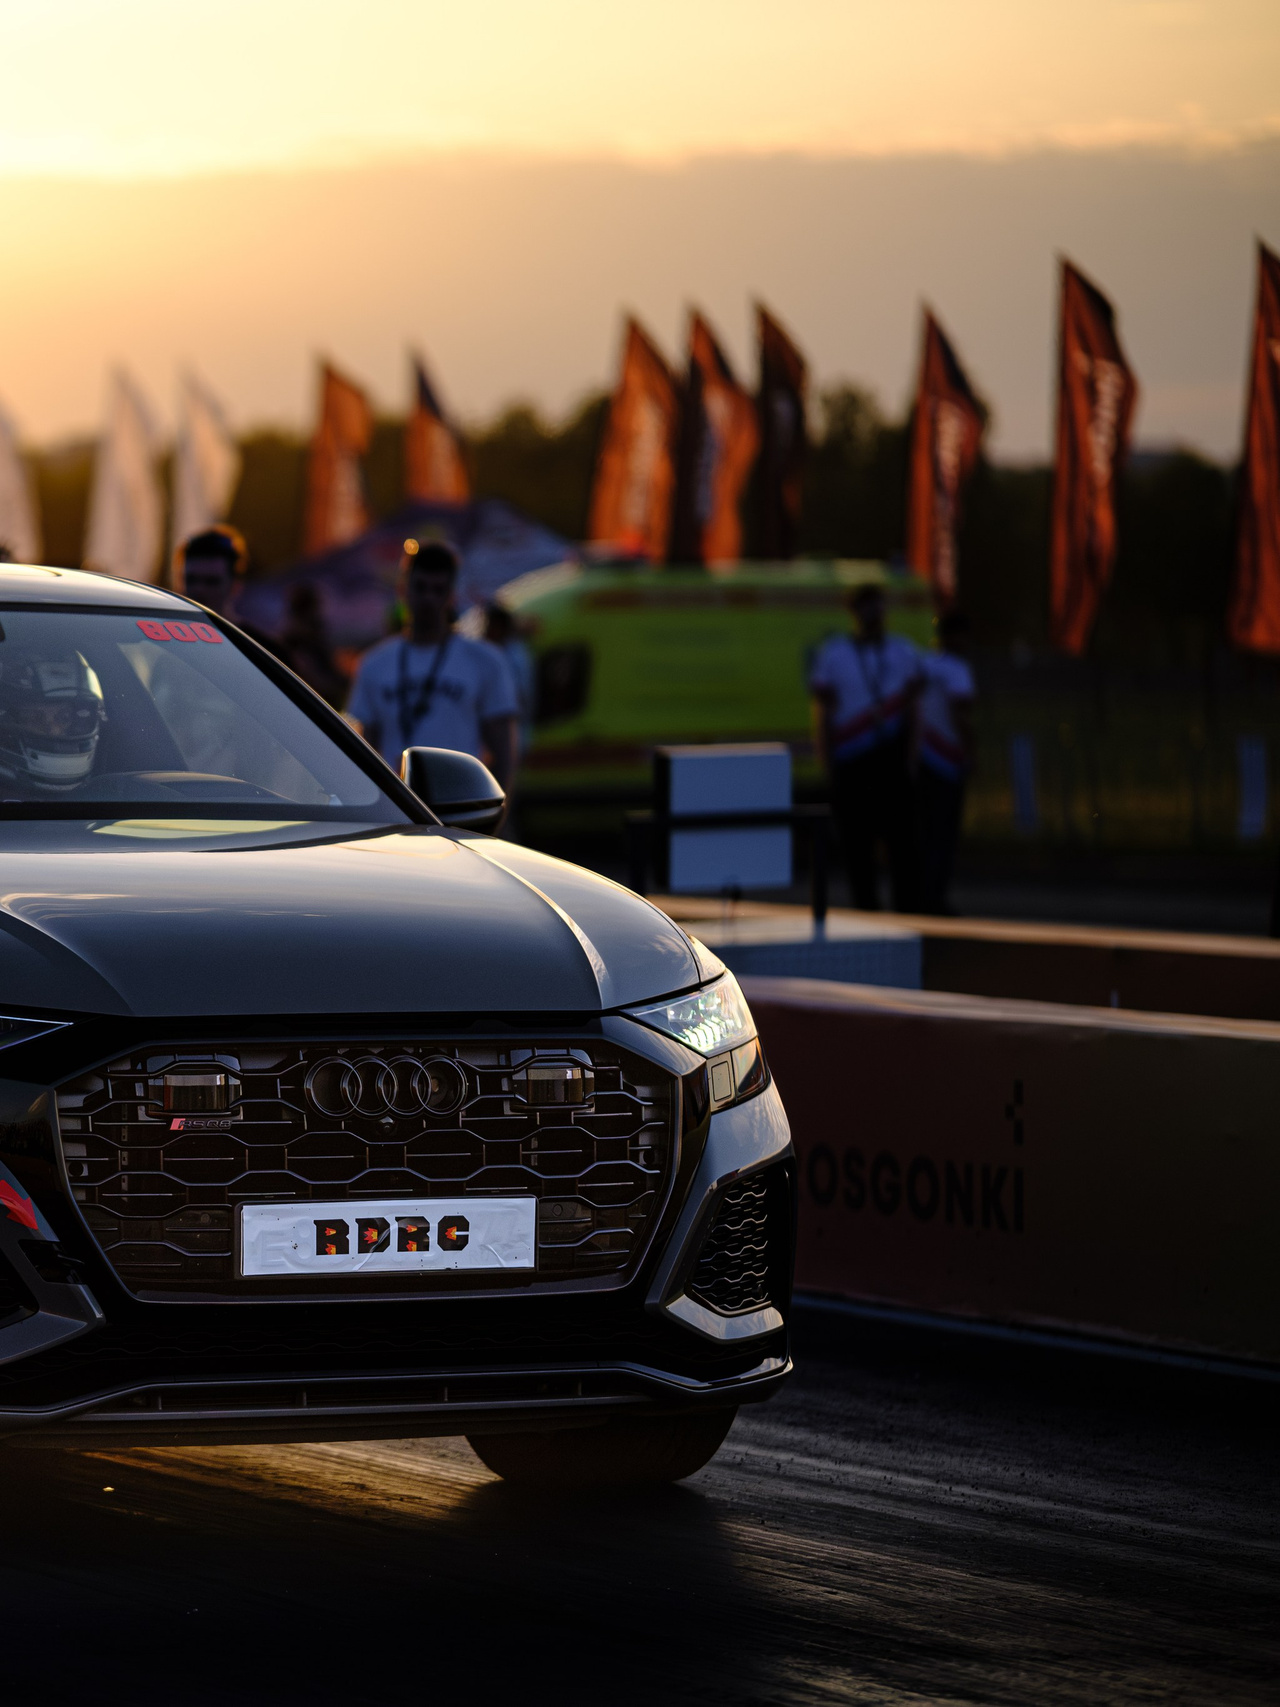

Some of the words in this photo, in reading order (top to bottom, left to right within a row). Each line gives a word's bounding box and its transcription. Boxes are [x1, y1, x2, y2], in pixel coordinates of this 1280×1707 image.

[136, 620, 223, 643] 800
[797, 1142, 1024, 1233] OSGONKI
[313, 1215, 470, 1256] RDRC
